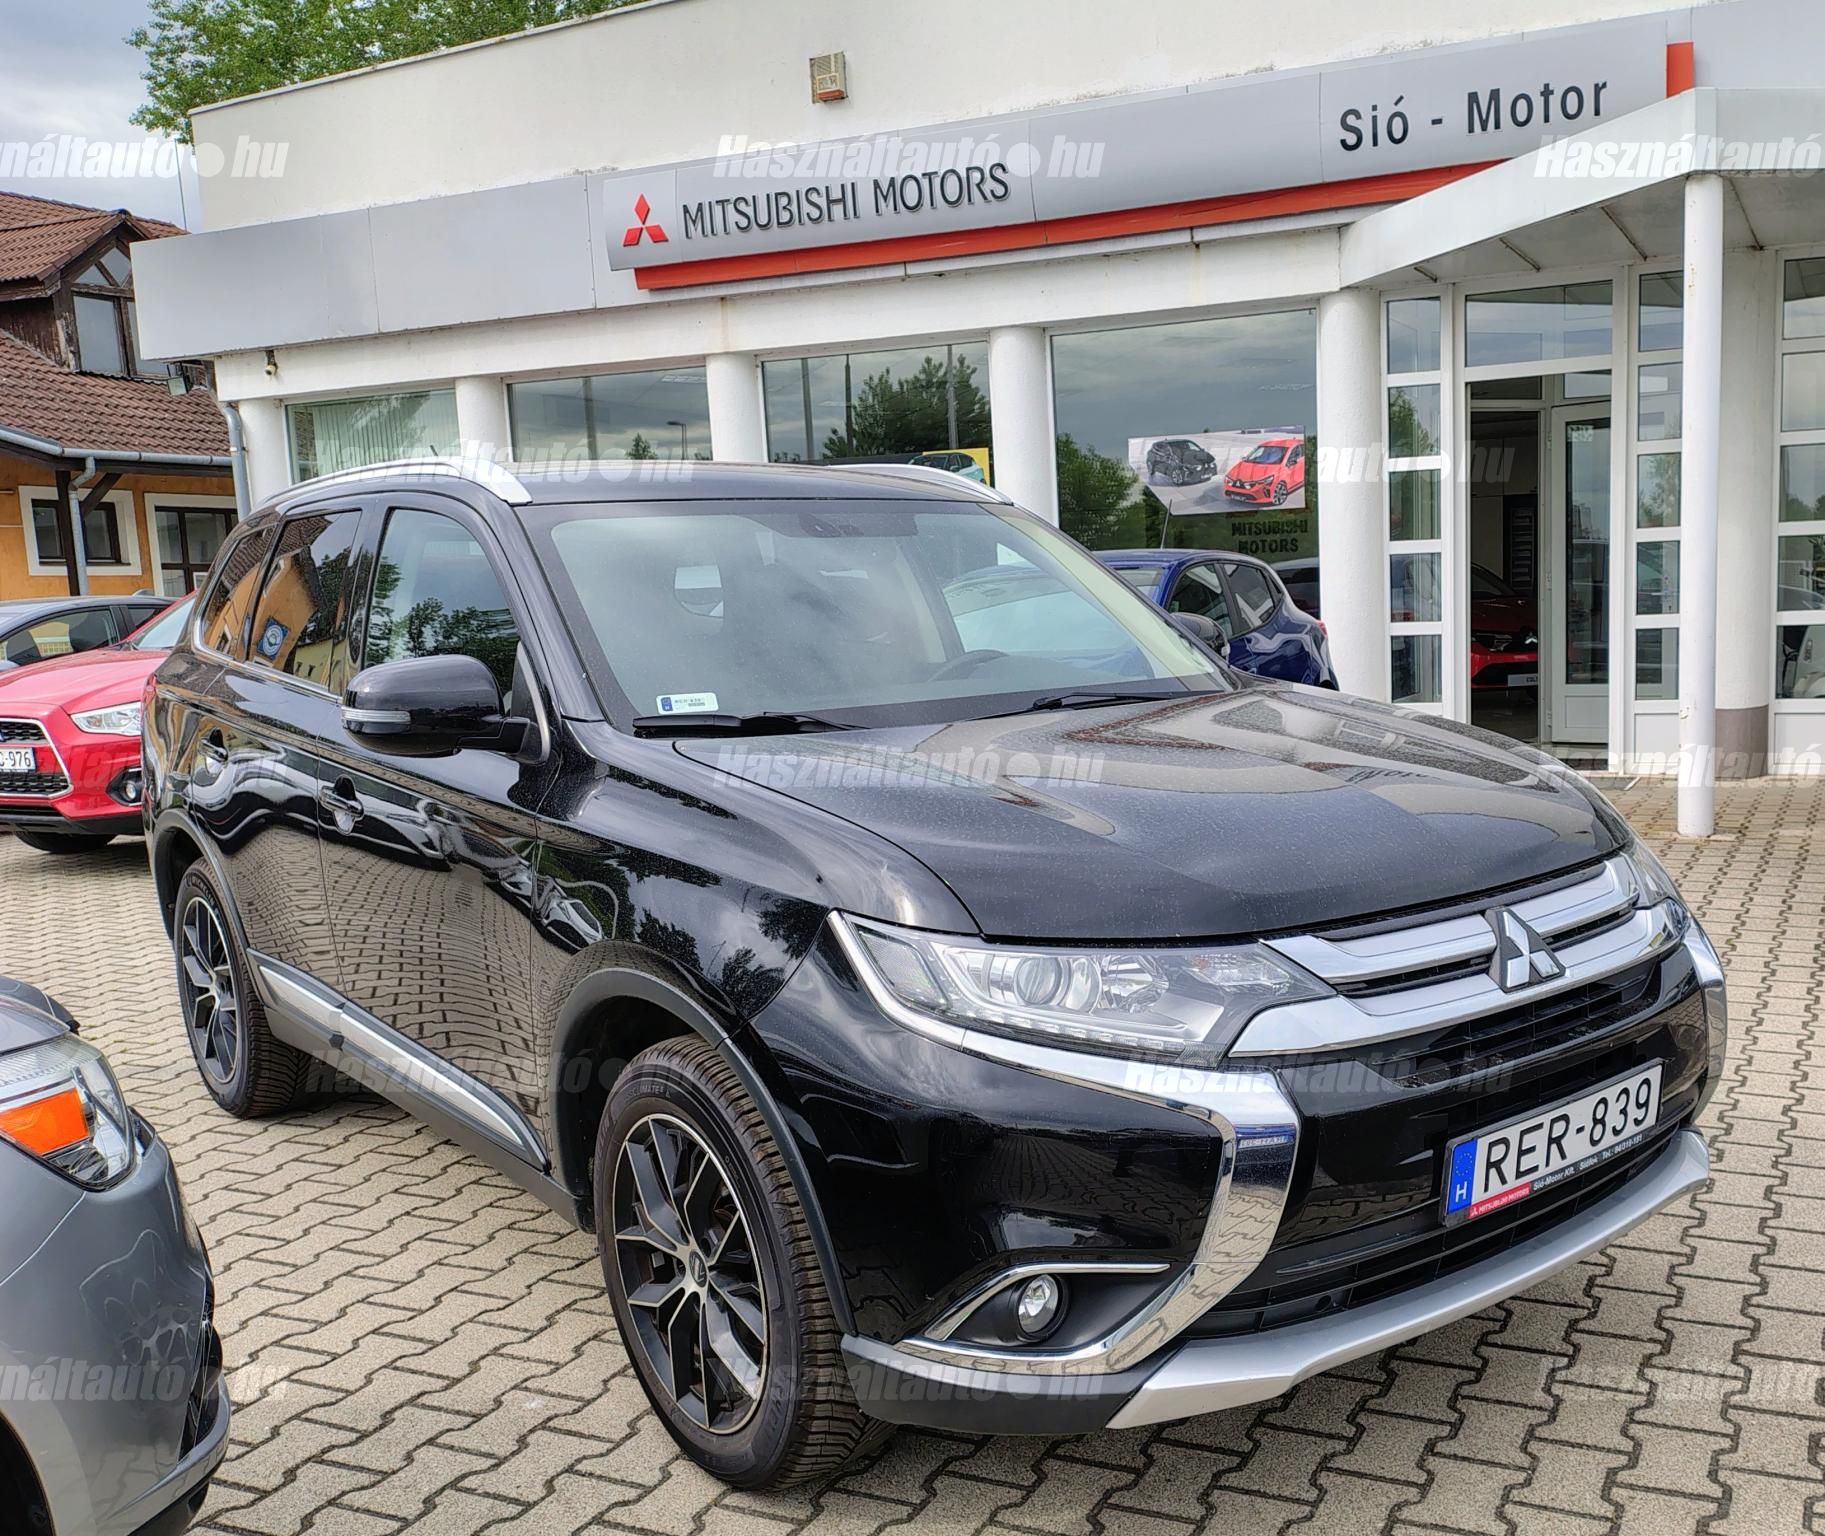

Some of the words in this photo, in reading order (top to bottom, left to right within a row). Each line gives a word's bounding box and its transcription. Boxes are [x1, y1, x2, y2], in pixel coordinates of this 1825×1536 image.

[1340, 95, 1409, 151] Sió
[1467, 81, 1607, 134] Motor
[683, 181, 860, 239] MITSUBISHI
[874, 162, 1010, 214] MOTORS
[1483, 1077, 1651, 1193] RER-839
[1455, 1181, 1468, 1203] H
